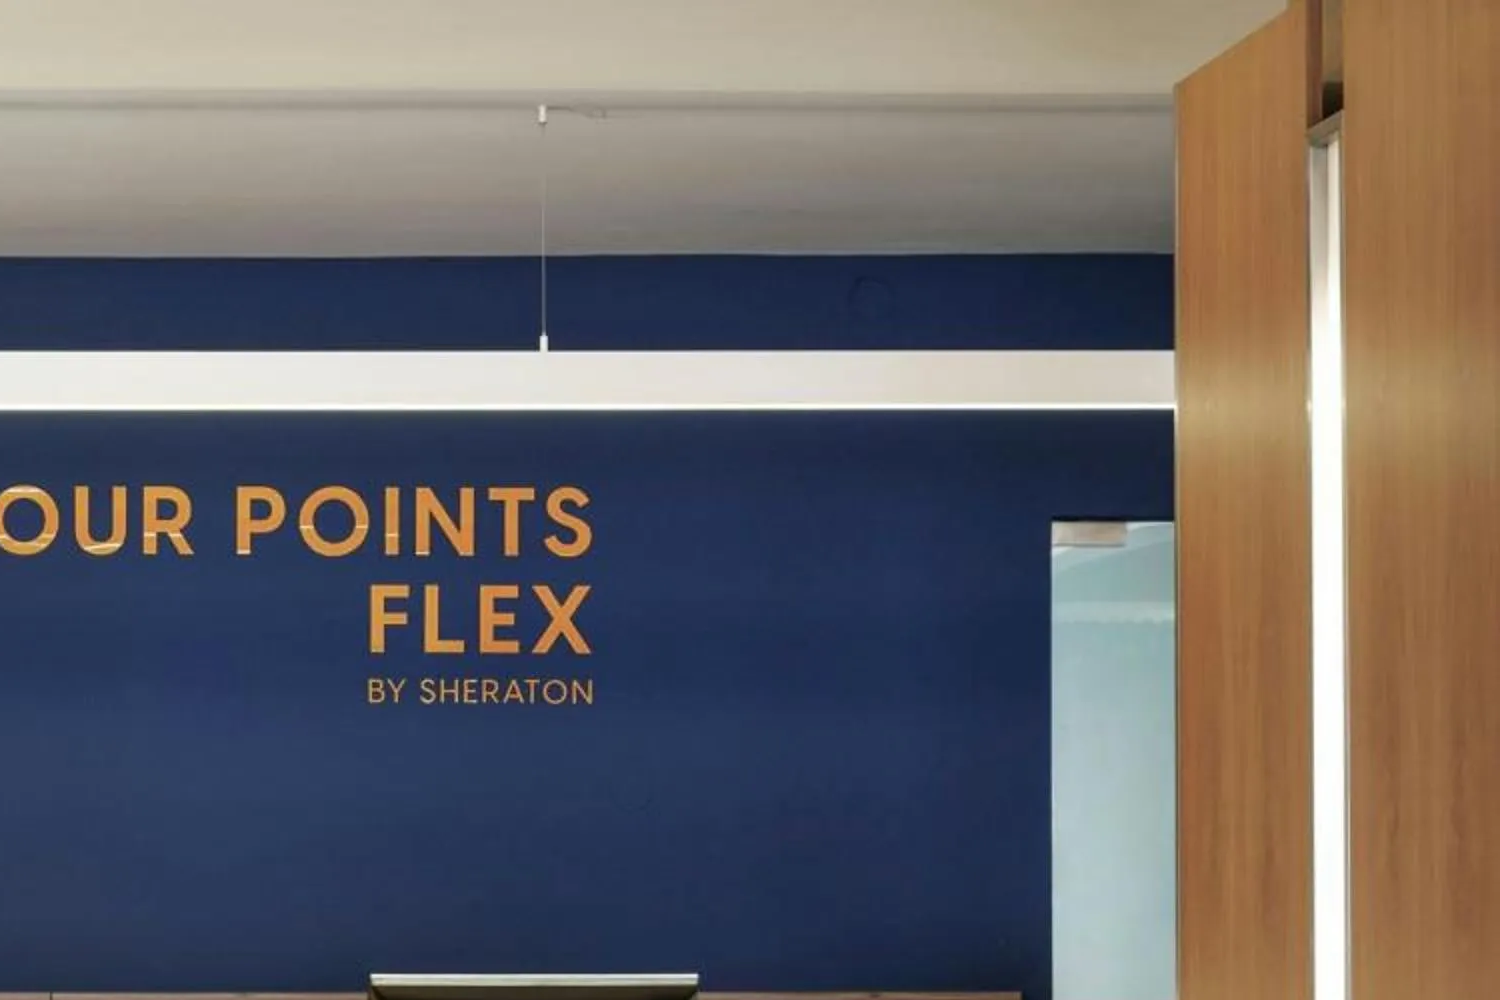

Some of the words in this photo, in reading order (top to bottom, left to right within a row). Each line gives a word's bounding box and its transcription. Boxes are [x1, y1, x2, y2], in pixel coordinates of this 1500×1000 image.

[235, 485, 593, 558] POINTS
[369, 584, 592, 654] FLEX
[368, 678, 406, 704] BY
[420, 678, 594, 706] SHERATON
